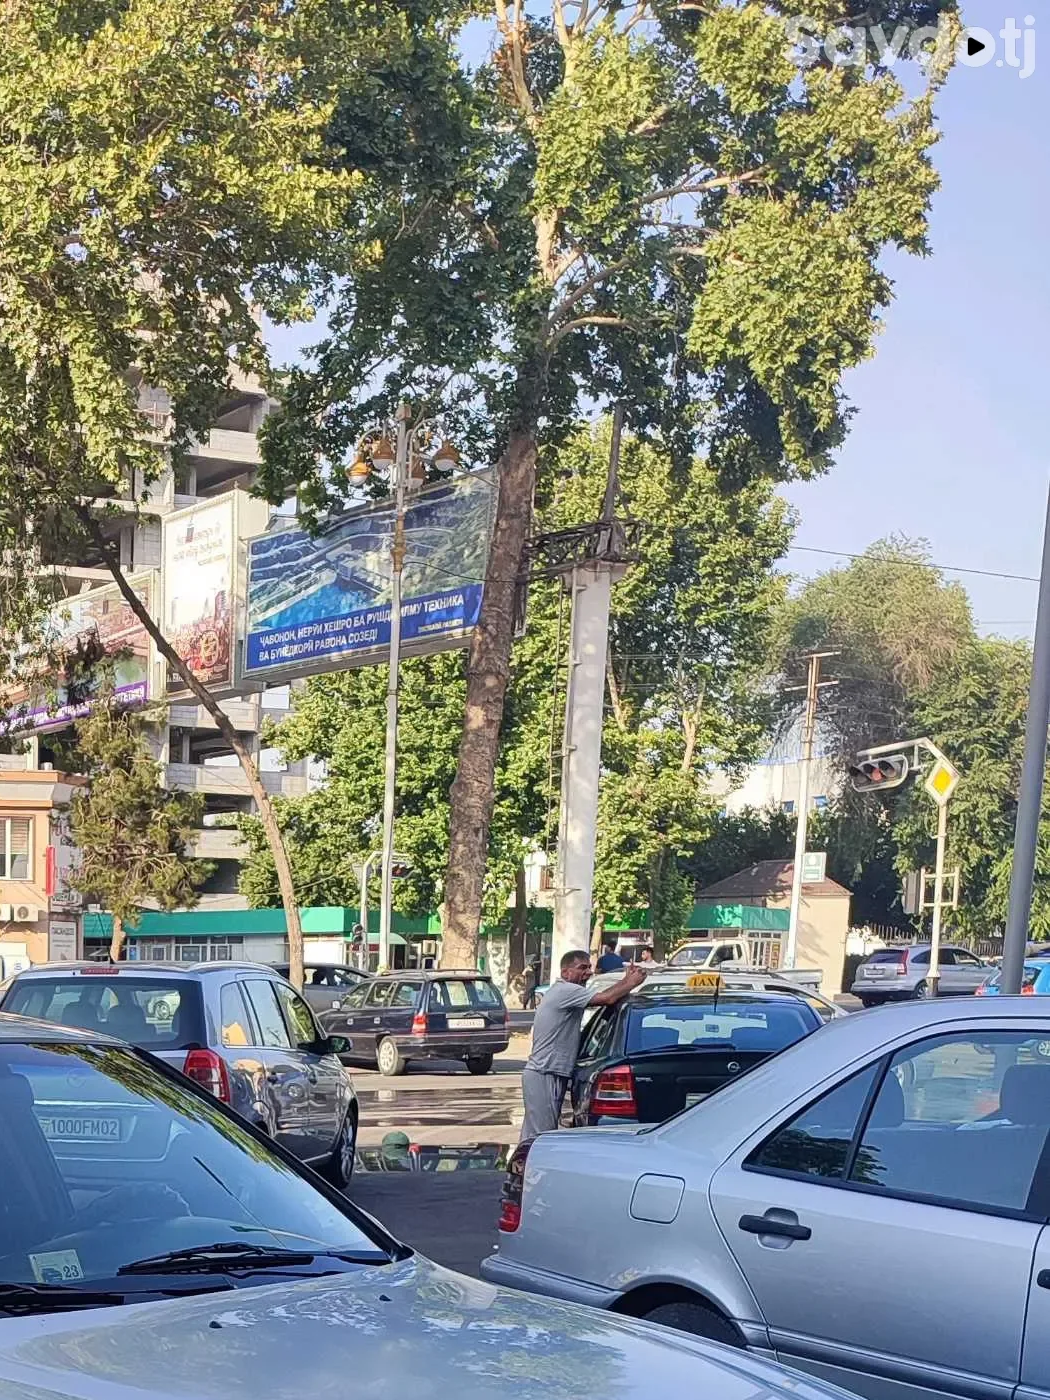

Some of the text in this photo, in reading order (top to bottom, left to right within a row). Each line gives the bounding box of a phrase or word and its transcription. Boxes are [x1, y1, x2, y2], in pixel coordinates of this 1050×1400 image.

[324, 619, 352, 634] ХЕШРО
[353, 615, 365, 627] БА
[366, 610, 391, 625] РУШД
[424, 594, 464, 612] ТЕХНИКА
[315, 635, 347, 651] РАВОНА
[62, 1264, 80, 1278] 23
